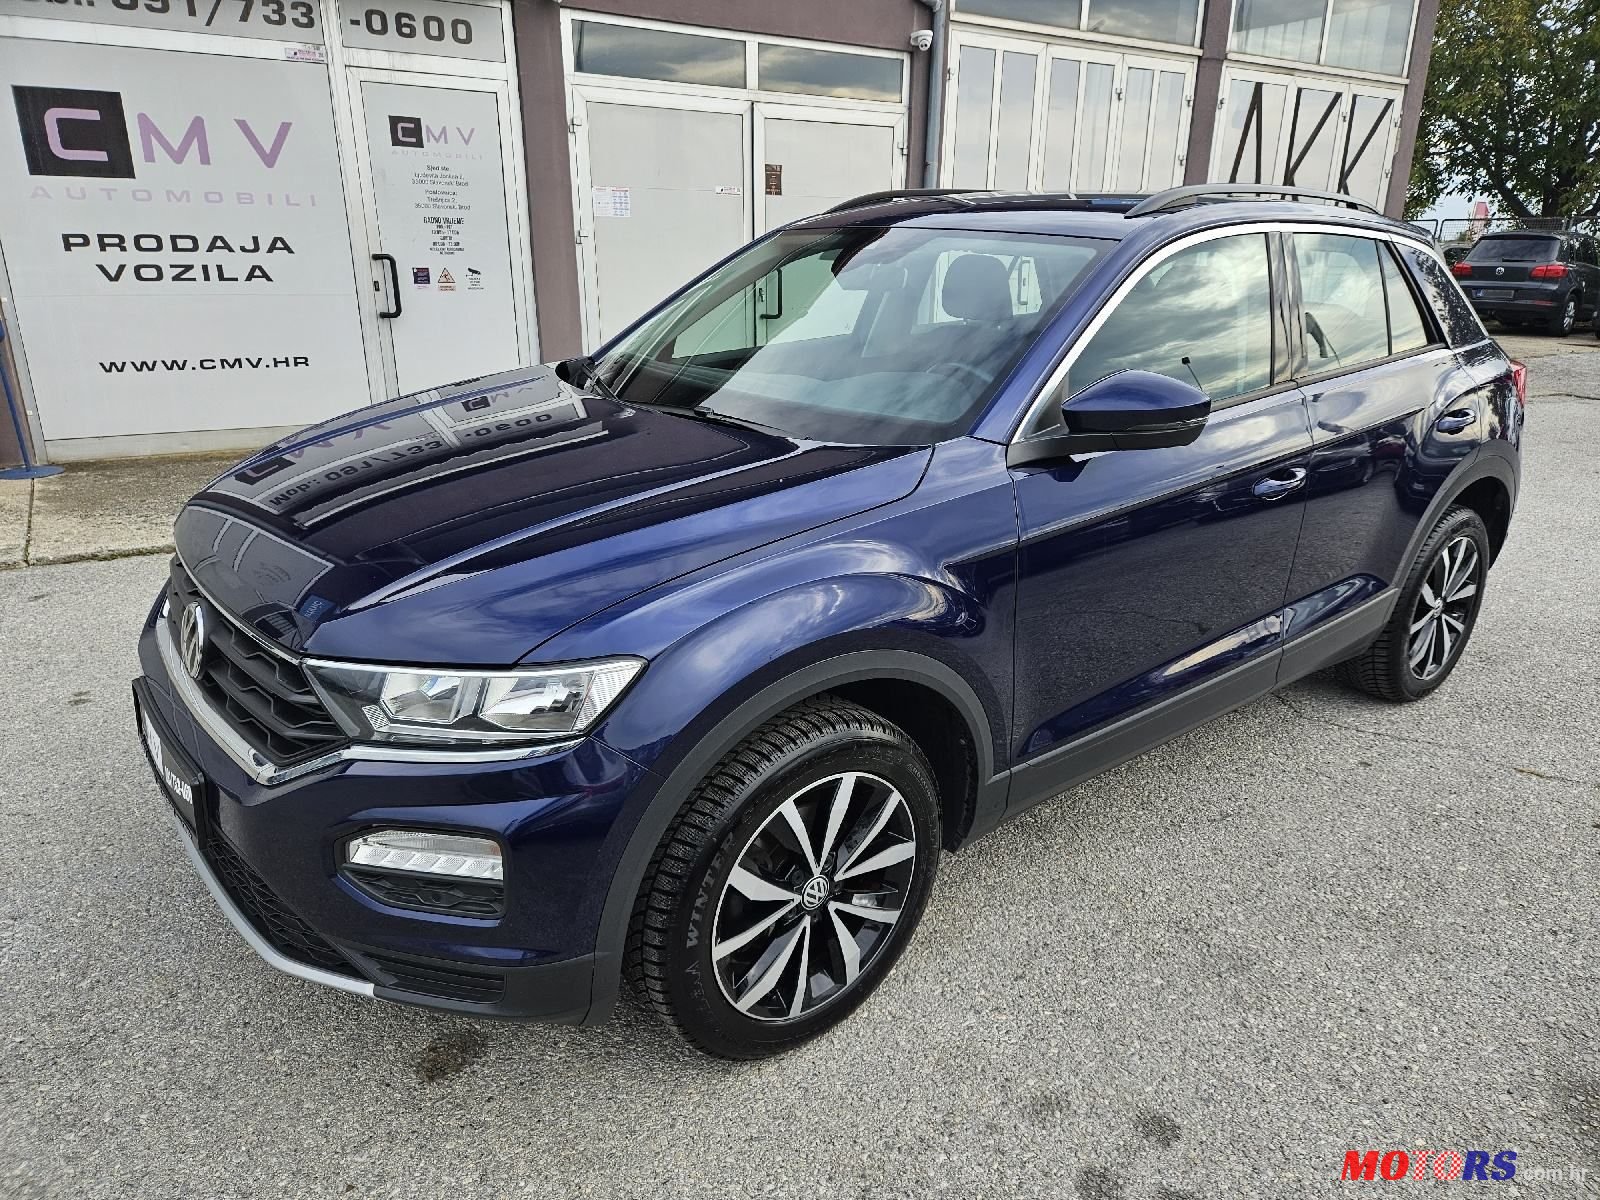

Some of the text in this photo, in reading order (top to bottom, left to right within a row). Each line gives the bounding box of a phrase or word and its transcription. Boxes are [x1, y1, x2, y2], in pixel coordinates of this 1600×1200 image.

[349, 9, 473, 45] -0600
[44, 107, 292, 168] CMV
[397, 122, 475, 146] CMV
[30, 186, 317, 207] AUTOMOBILI
[62, 233, 295, 254] PRODAJA
[95, 264, 274, 282] VOZILA
[99, 356, 310, 373] WWW.CMV.HR
